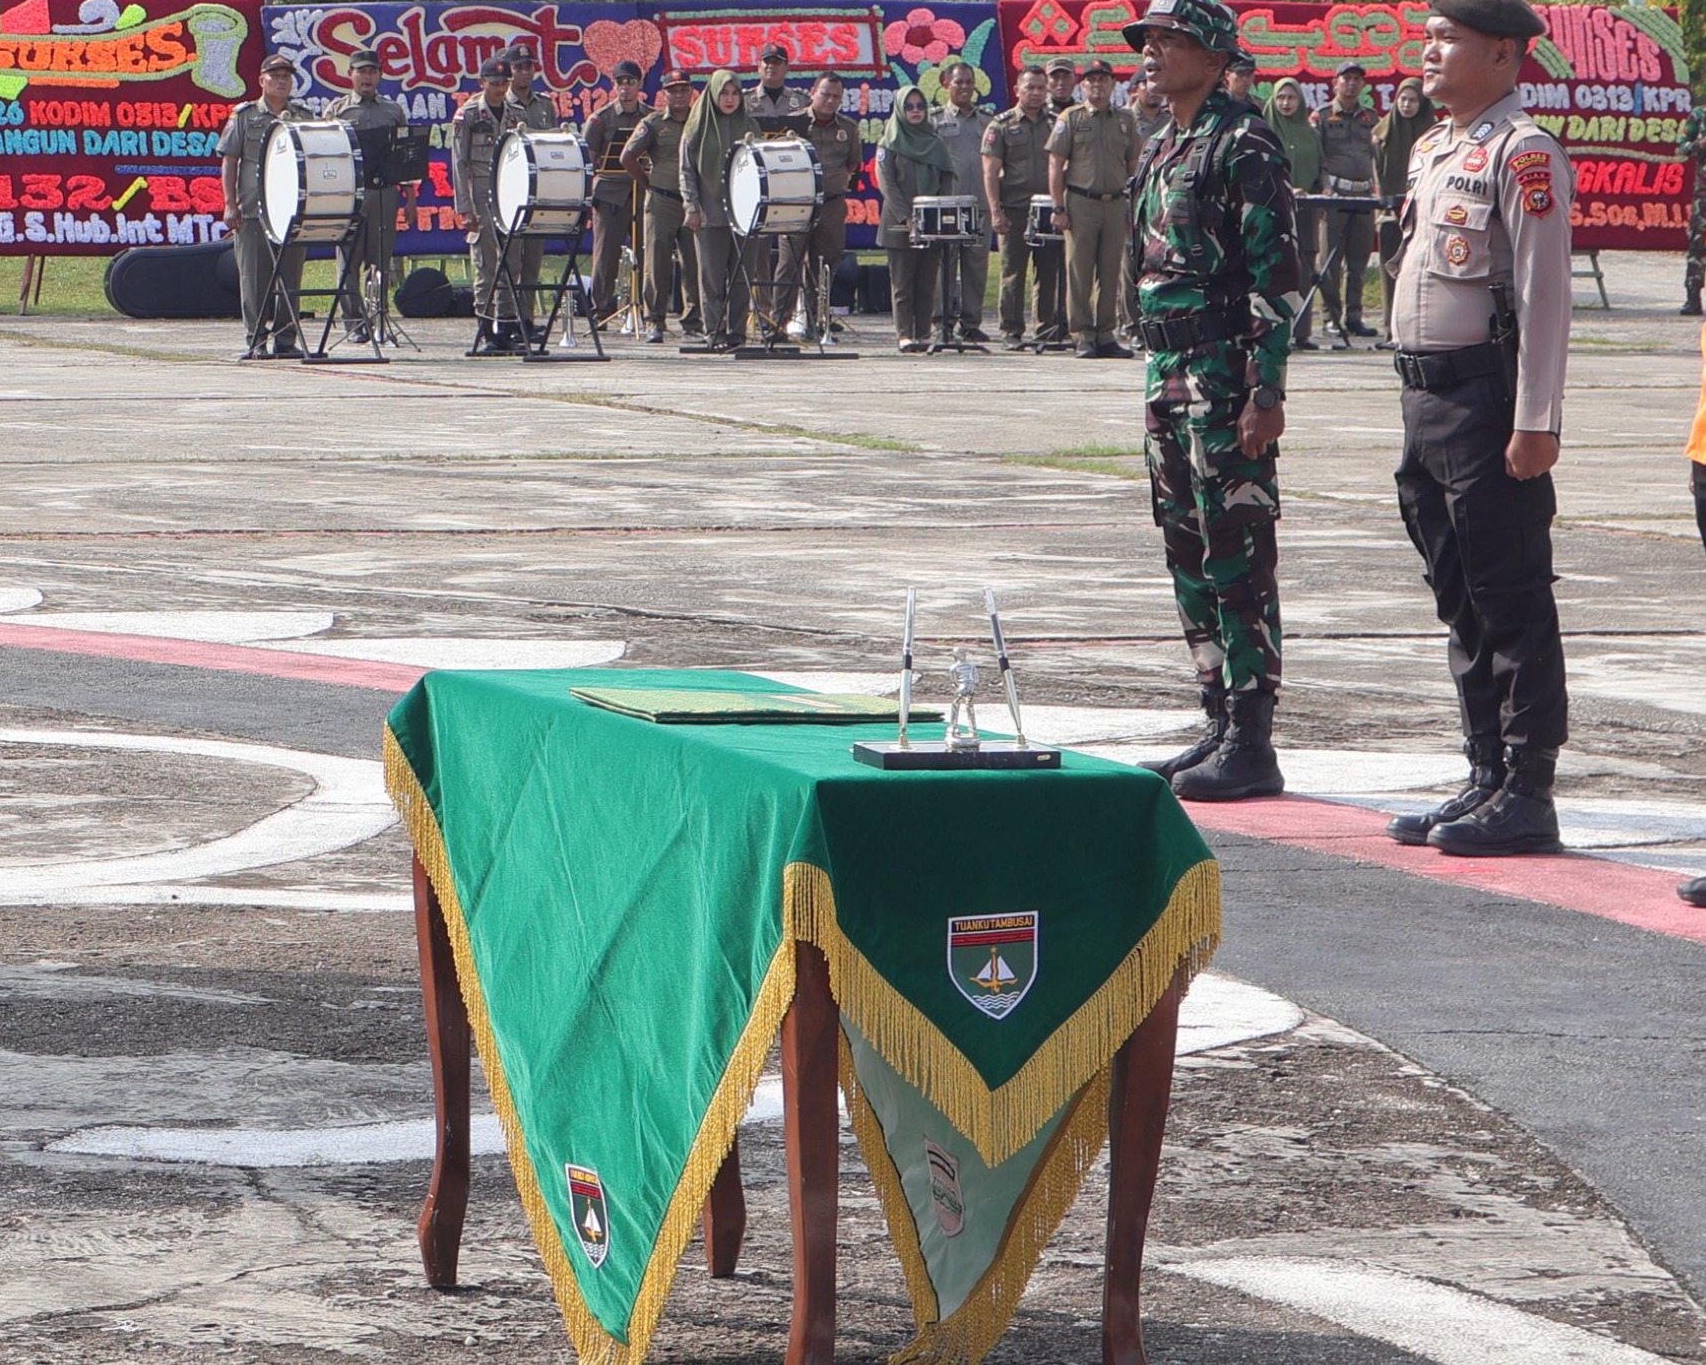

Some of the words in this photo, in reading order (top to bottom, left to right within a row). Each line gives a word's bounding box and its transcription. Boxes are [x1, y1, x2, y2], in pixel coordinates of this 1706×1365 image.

[1519, 82, 1571, 111] DIM
[29, 99, 112, 127] KODIM
[1567, 114, 1626, 142] DARI
[82, 130, 149, 157] DARI
[1446, 175, 1488, 196] POLRI
[1572, 161, 1685, 196] GKALIS
[955, 920, 989, 932] TUANKU
[991, 916, 1033, 929] TAMBUSAI
